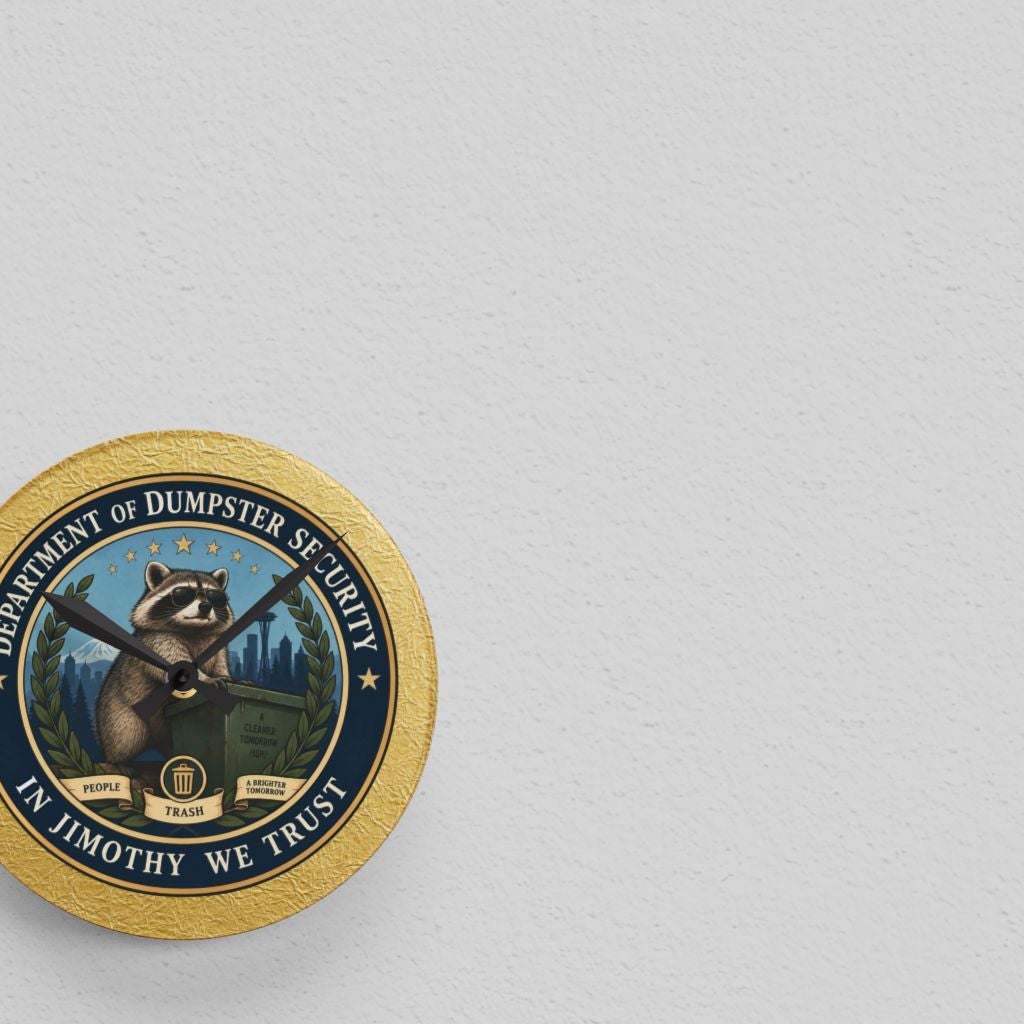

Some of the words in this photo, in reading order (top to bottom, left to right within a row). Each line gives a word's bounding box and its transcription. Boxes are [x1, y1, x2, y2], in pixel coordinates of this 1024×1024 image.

[287, 528, 378, 651] SECURITY
[83, 782, 121, 793] PEOPLE
[253, 780, 286, 788] BRIGHTER
[246, 787, 285, 796] TOMORROW
[165, 806, 204, 817] TRASH
[15, 776, 53, 813] IN
[49, 812, 186, 877] JIMOTHY
[205, 844, 254, 875] WE
[261, 776, 348, 857] TRUST
